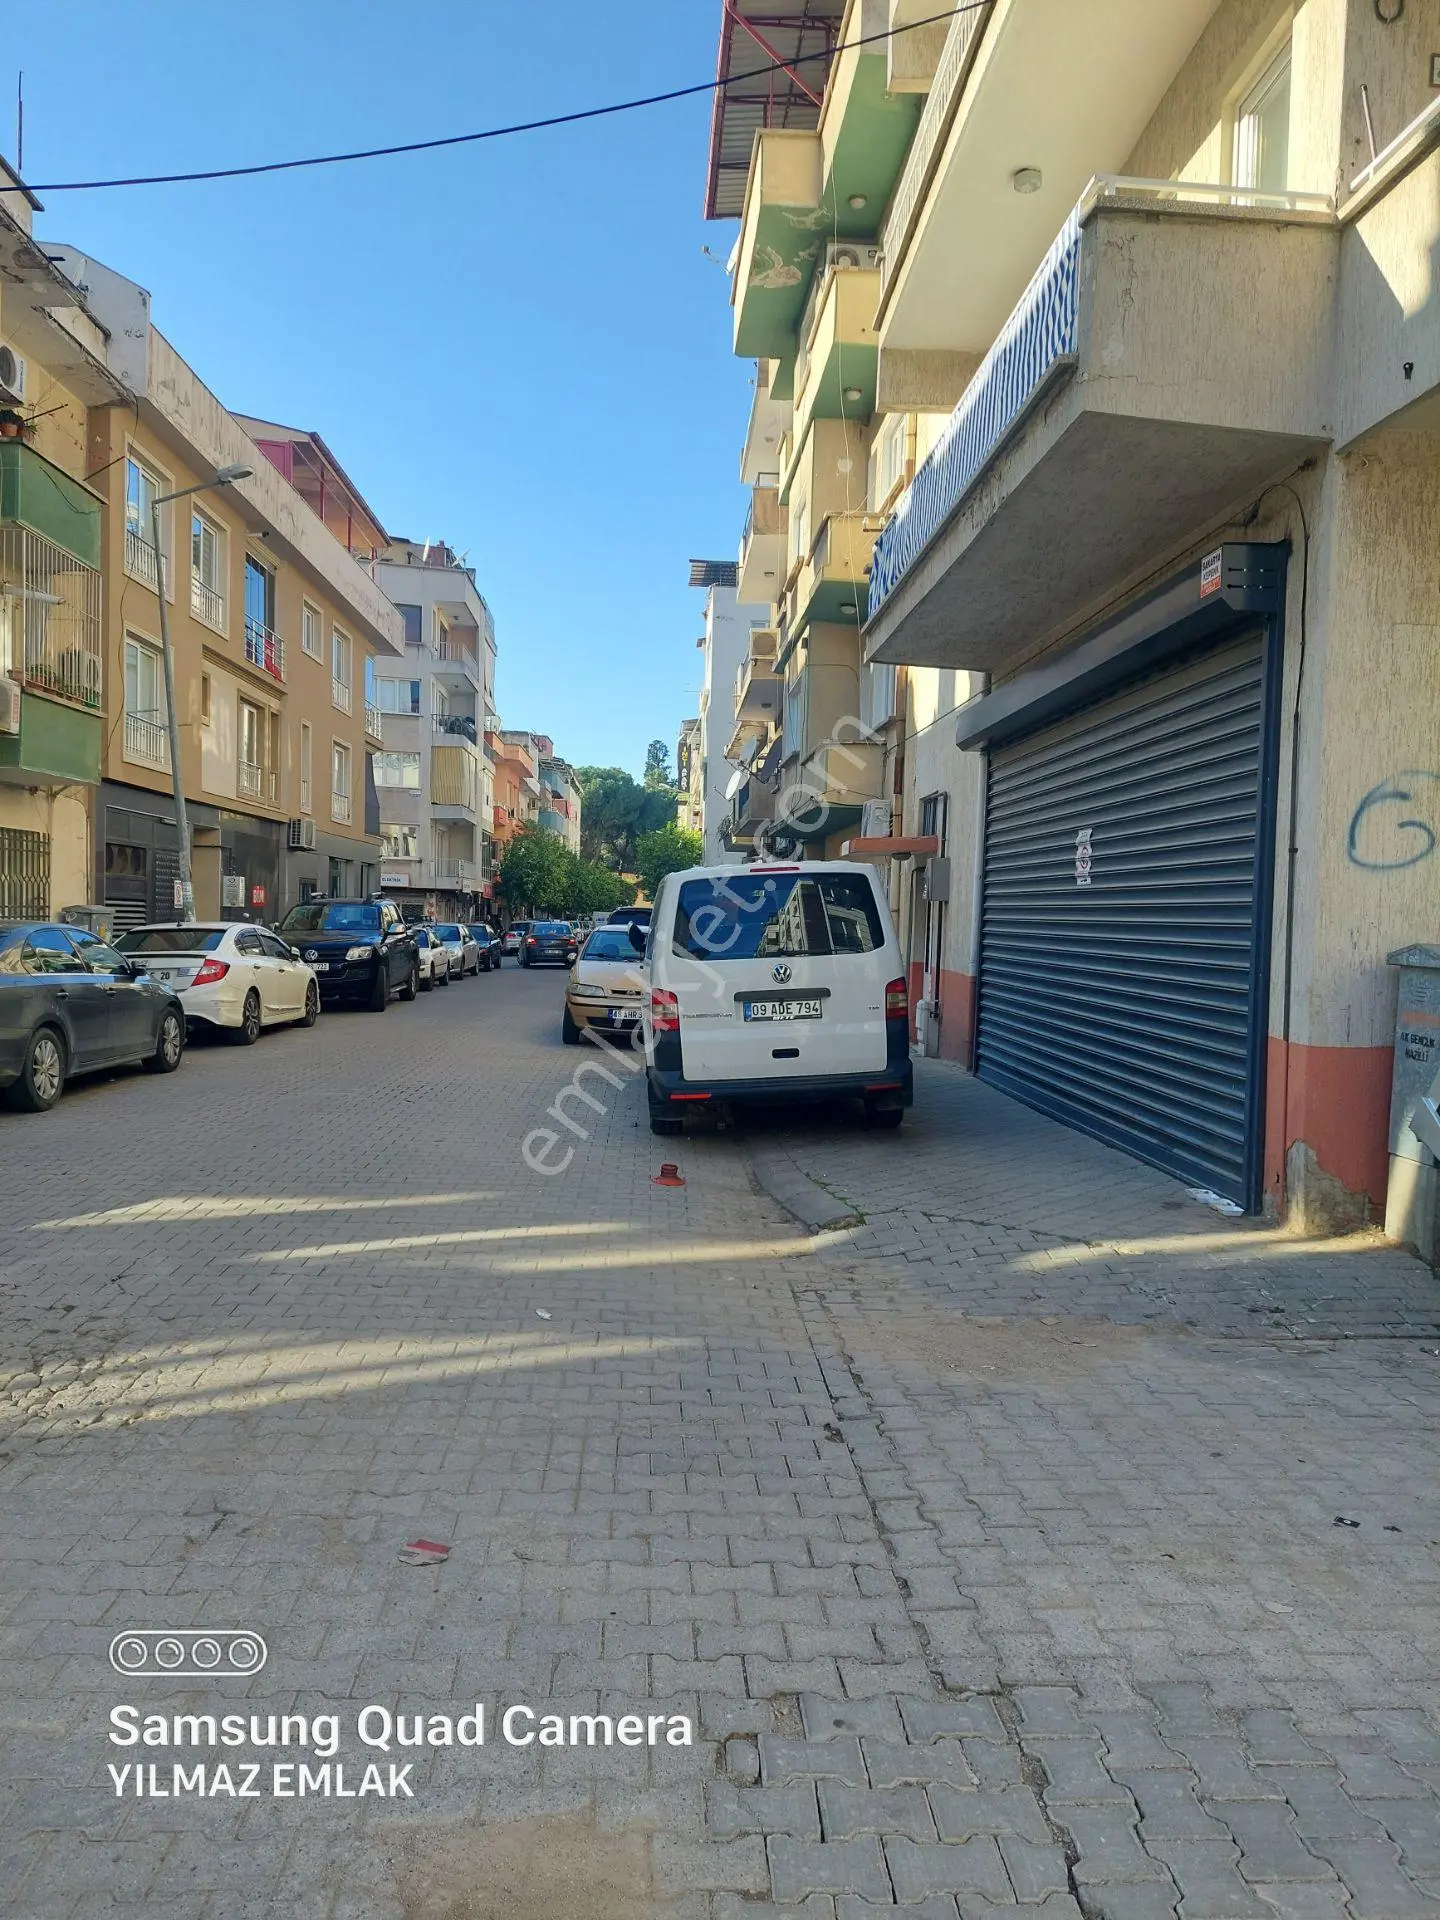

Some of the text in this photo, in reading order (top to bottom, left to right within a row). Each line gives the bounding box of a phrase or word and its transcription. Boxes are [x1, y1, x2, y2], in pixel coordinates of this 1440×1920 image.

[752, 1001, 819, 1016] 09 ADE 794
